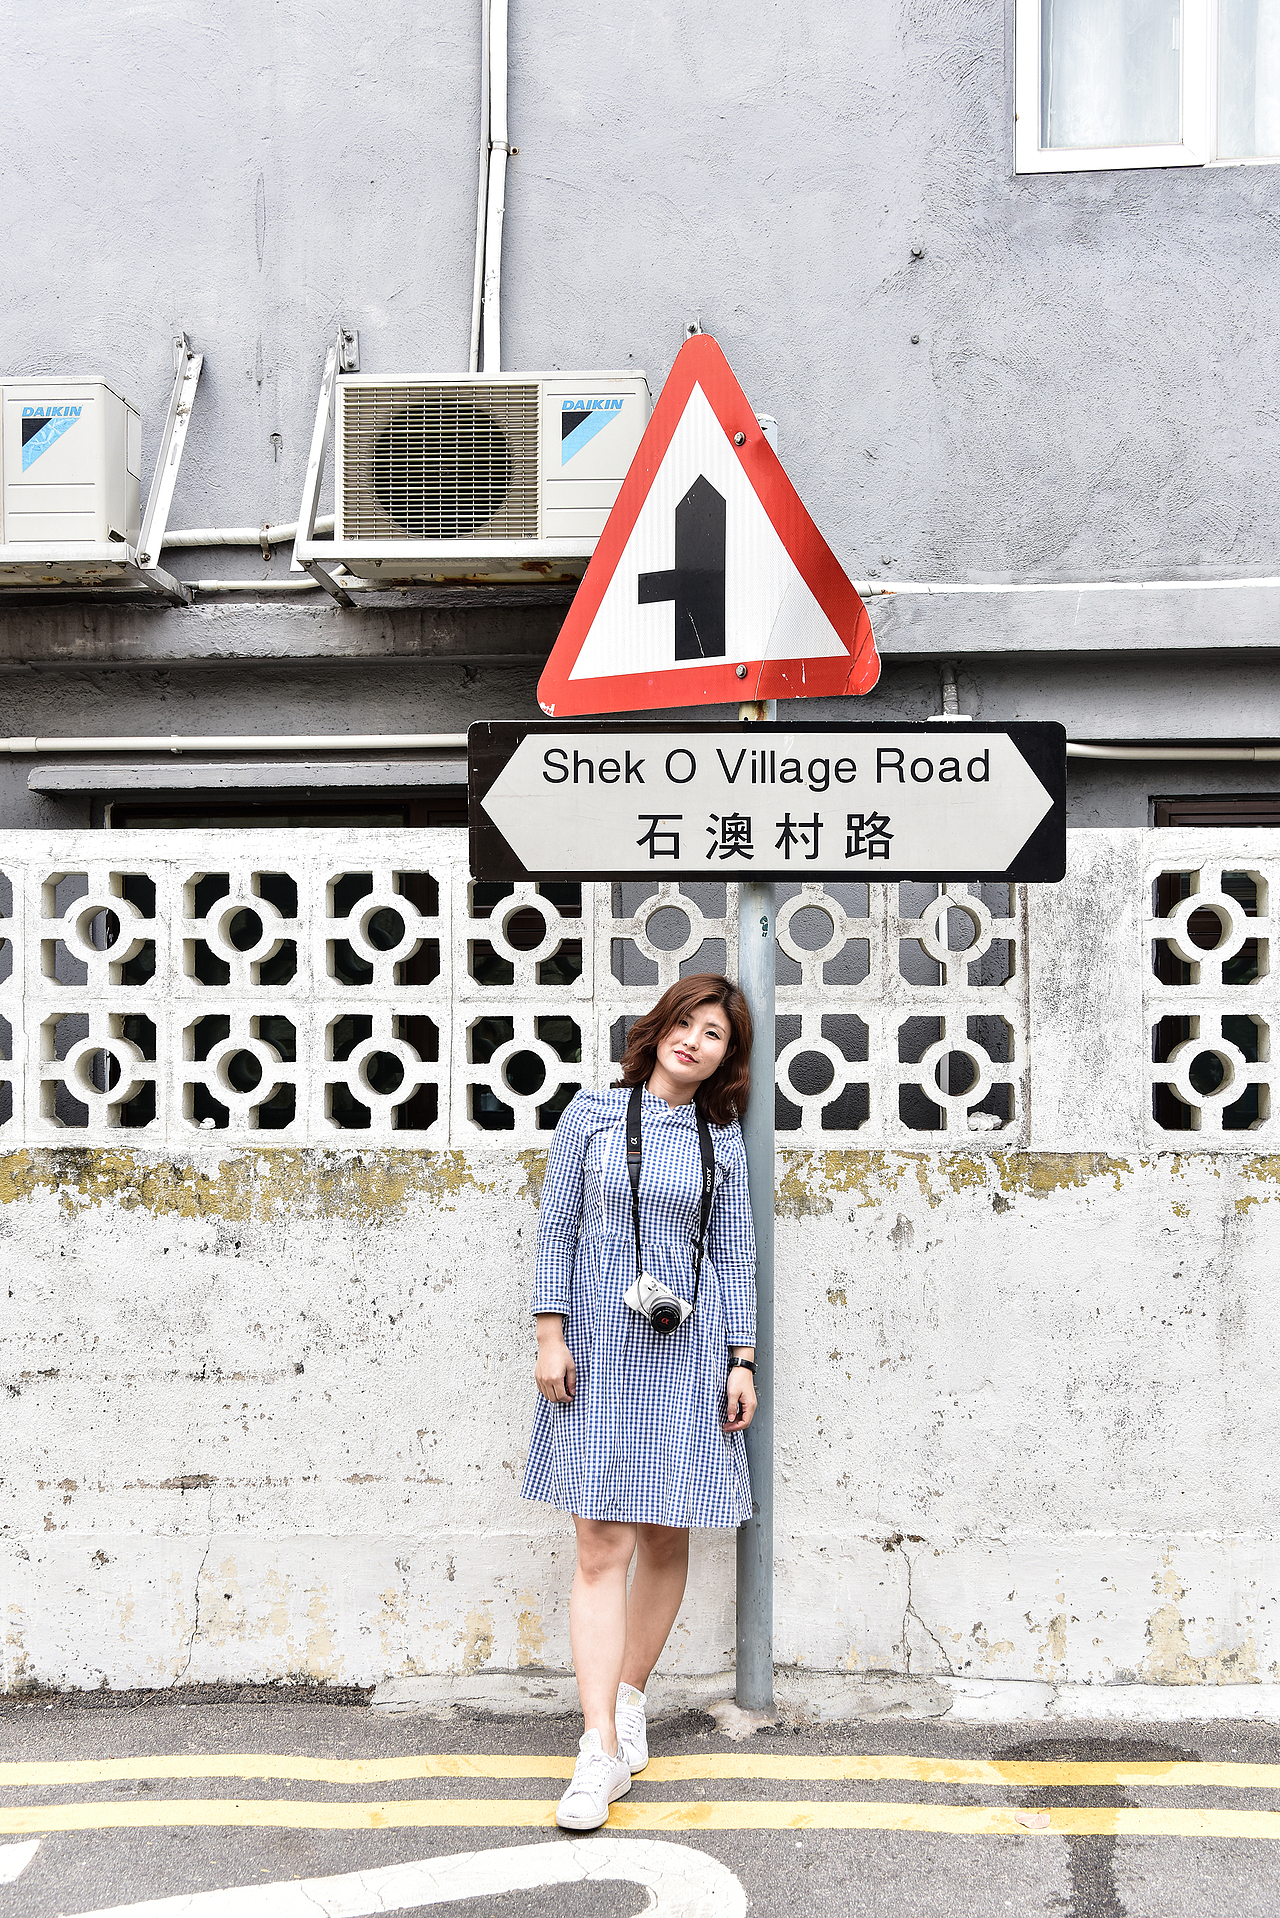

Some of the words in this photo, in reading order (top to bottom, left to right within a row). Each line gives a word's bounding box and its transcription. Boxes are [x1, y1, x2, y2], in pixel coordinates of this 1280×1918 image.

[21, 406, 82, 417] DAIKIN
[561, 399, 624, 410] DAIKIN
[542, 748, 646, 784] Shek
[665, 748, 697, 784] O
[715, 748, 857, 792] Village
[876, 747, 990, 784] Road
[636, 810, 895, 861] 石澳村路
